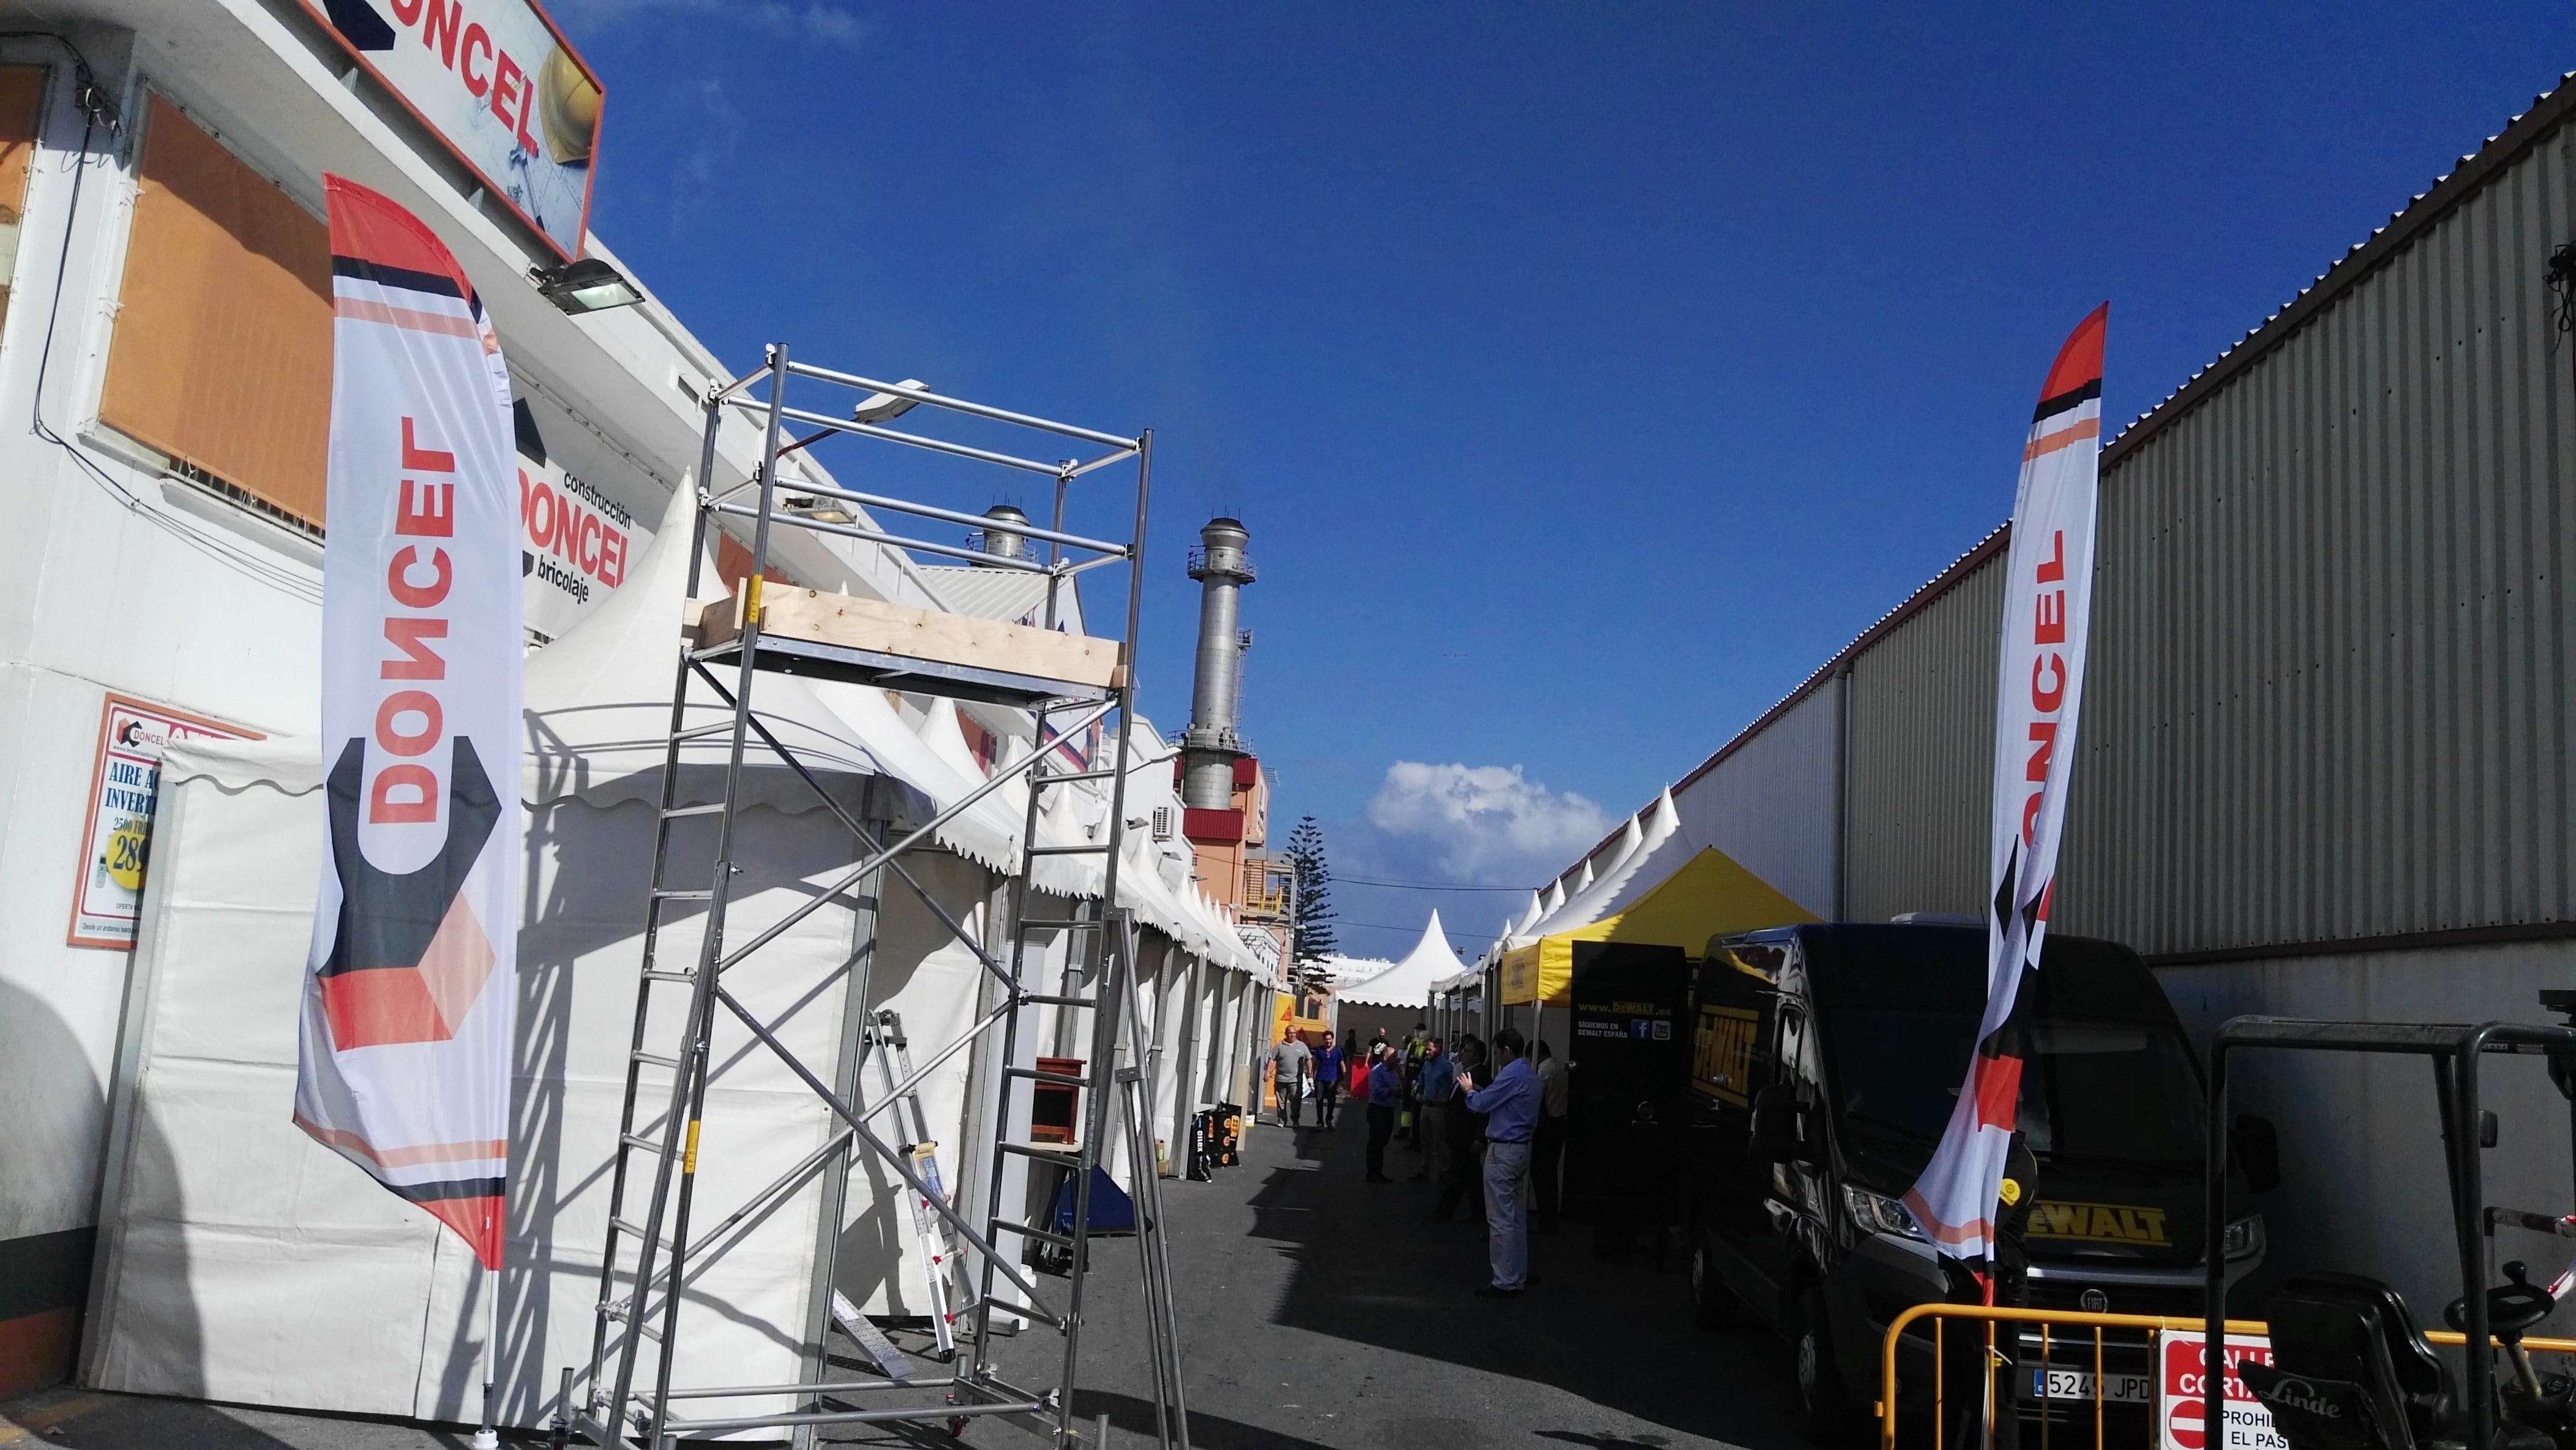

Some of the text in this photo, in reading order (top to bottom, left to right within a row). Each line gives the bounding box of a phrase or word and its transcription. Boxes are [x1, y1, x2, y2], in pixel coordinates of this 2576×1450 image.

[564, 471, 631, 530] construcción
[537, 554, 590, 605] bricolaje
[134, 730, 164, 746] DONCEL
[109, 762, 143, 787] AIRE
[113, 817, 132, 833] 2500
[2027, 1203, 2167, 1242] EWALT
[2087, 1297, 2104, 1310] FIAT
[2258, 1378, 2342, 1419] Linde
[2231, 1431, 2251, 1446] EL
